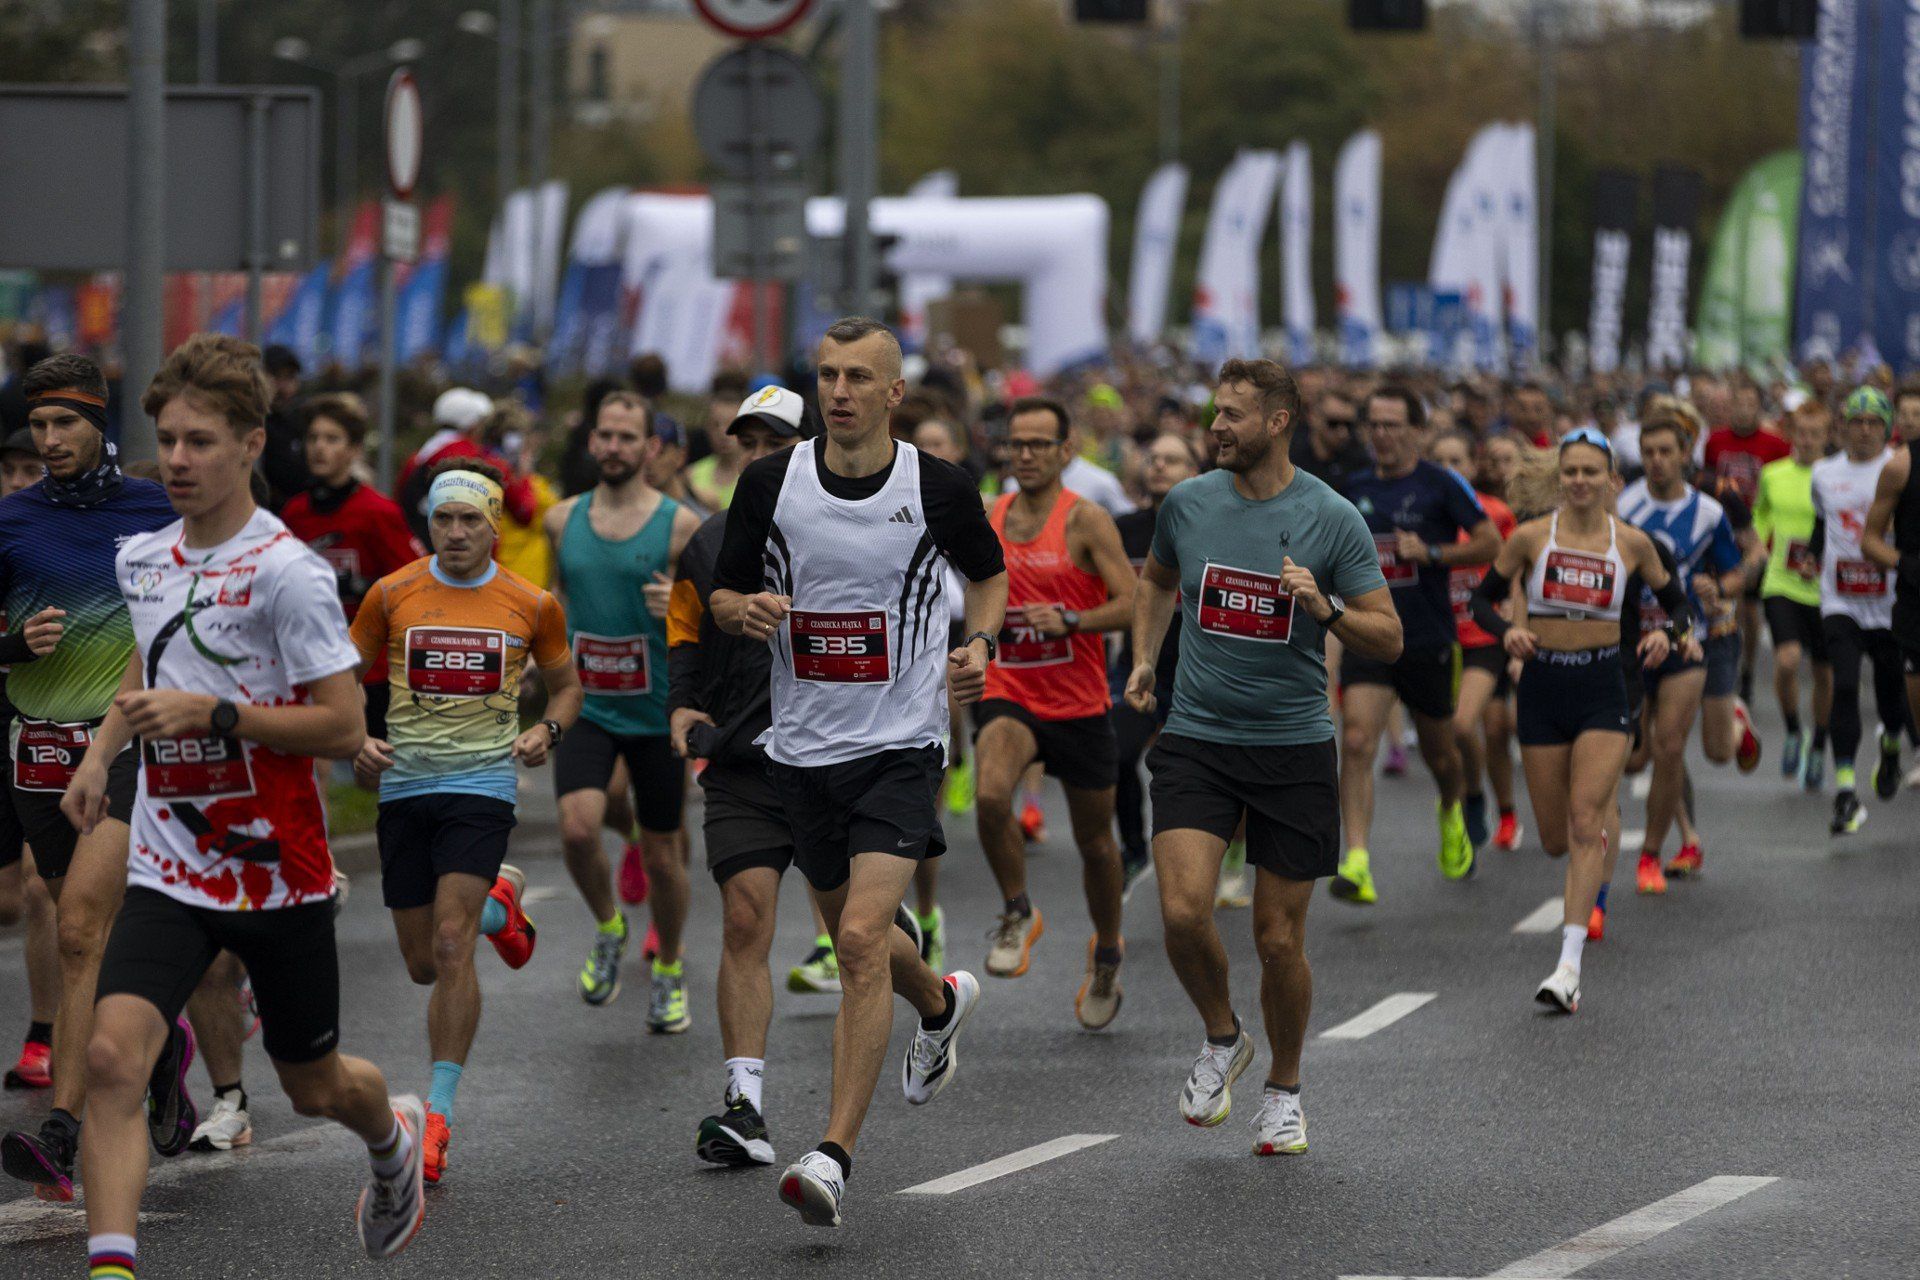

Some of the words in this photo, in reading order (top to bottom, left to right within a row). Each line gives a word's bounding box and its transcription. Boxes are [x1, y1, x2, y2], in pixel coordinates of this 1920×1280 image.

[1218, 589, 1275, 615] 1815
[810, 620, 840, 629] CZANIECKA
[841, 621, 863, 630] PIĄTKA
[808, 635, 867, 655] 335
[424, 650, 485, 671] 282
[28, 745, 71, 765] 120
[150, 738, 227, 764] 1283
